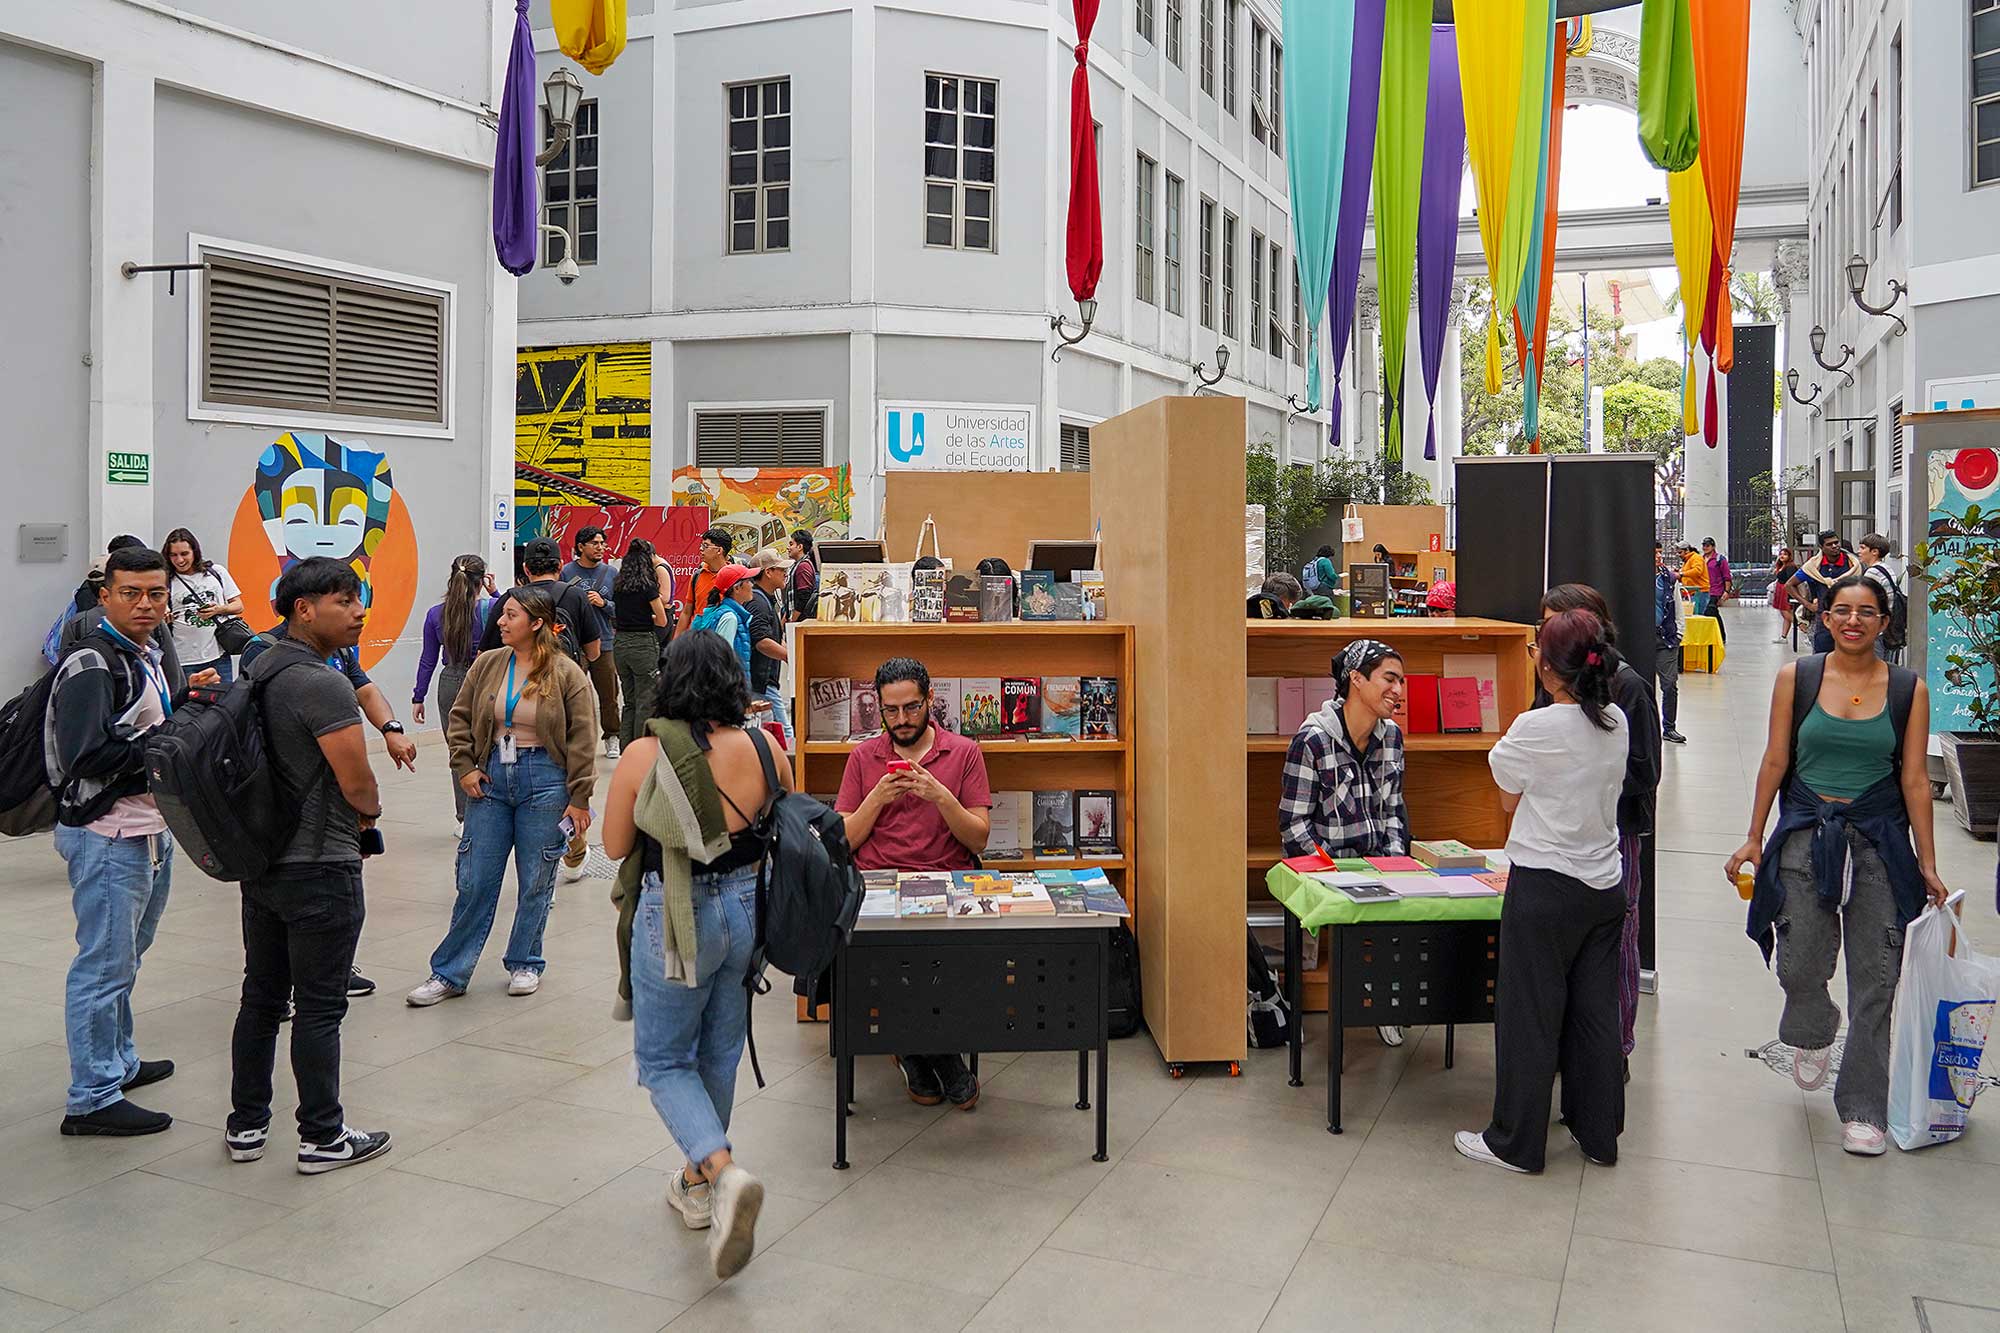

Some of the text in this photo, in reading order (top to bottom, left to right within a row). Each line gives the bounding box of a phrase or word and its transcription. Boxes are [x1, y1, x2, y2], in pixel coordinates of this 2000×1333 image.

[946, 415, 1025, 432] Universidad
[946, 433, 1025, 449] de las Artes
[110, 454, 147, 469] SALIDA
[946, 452, 1025, 467] del Ecuador
[1005, 683, 1036, 695] COMÚN
